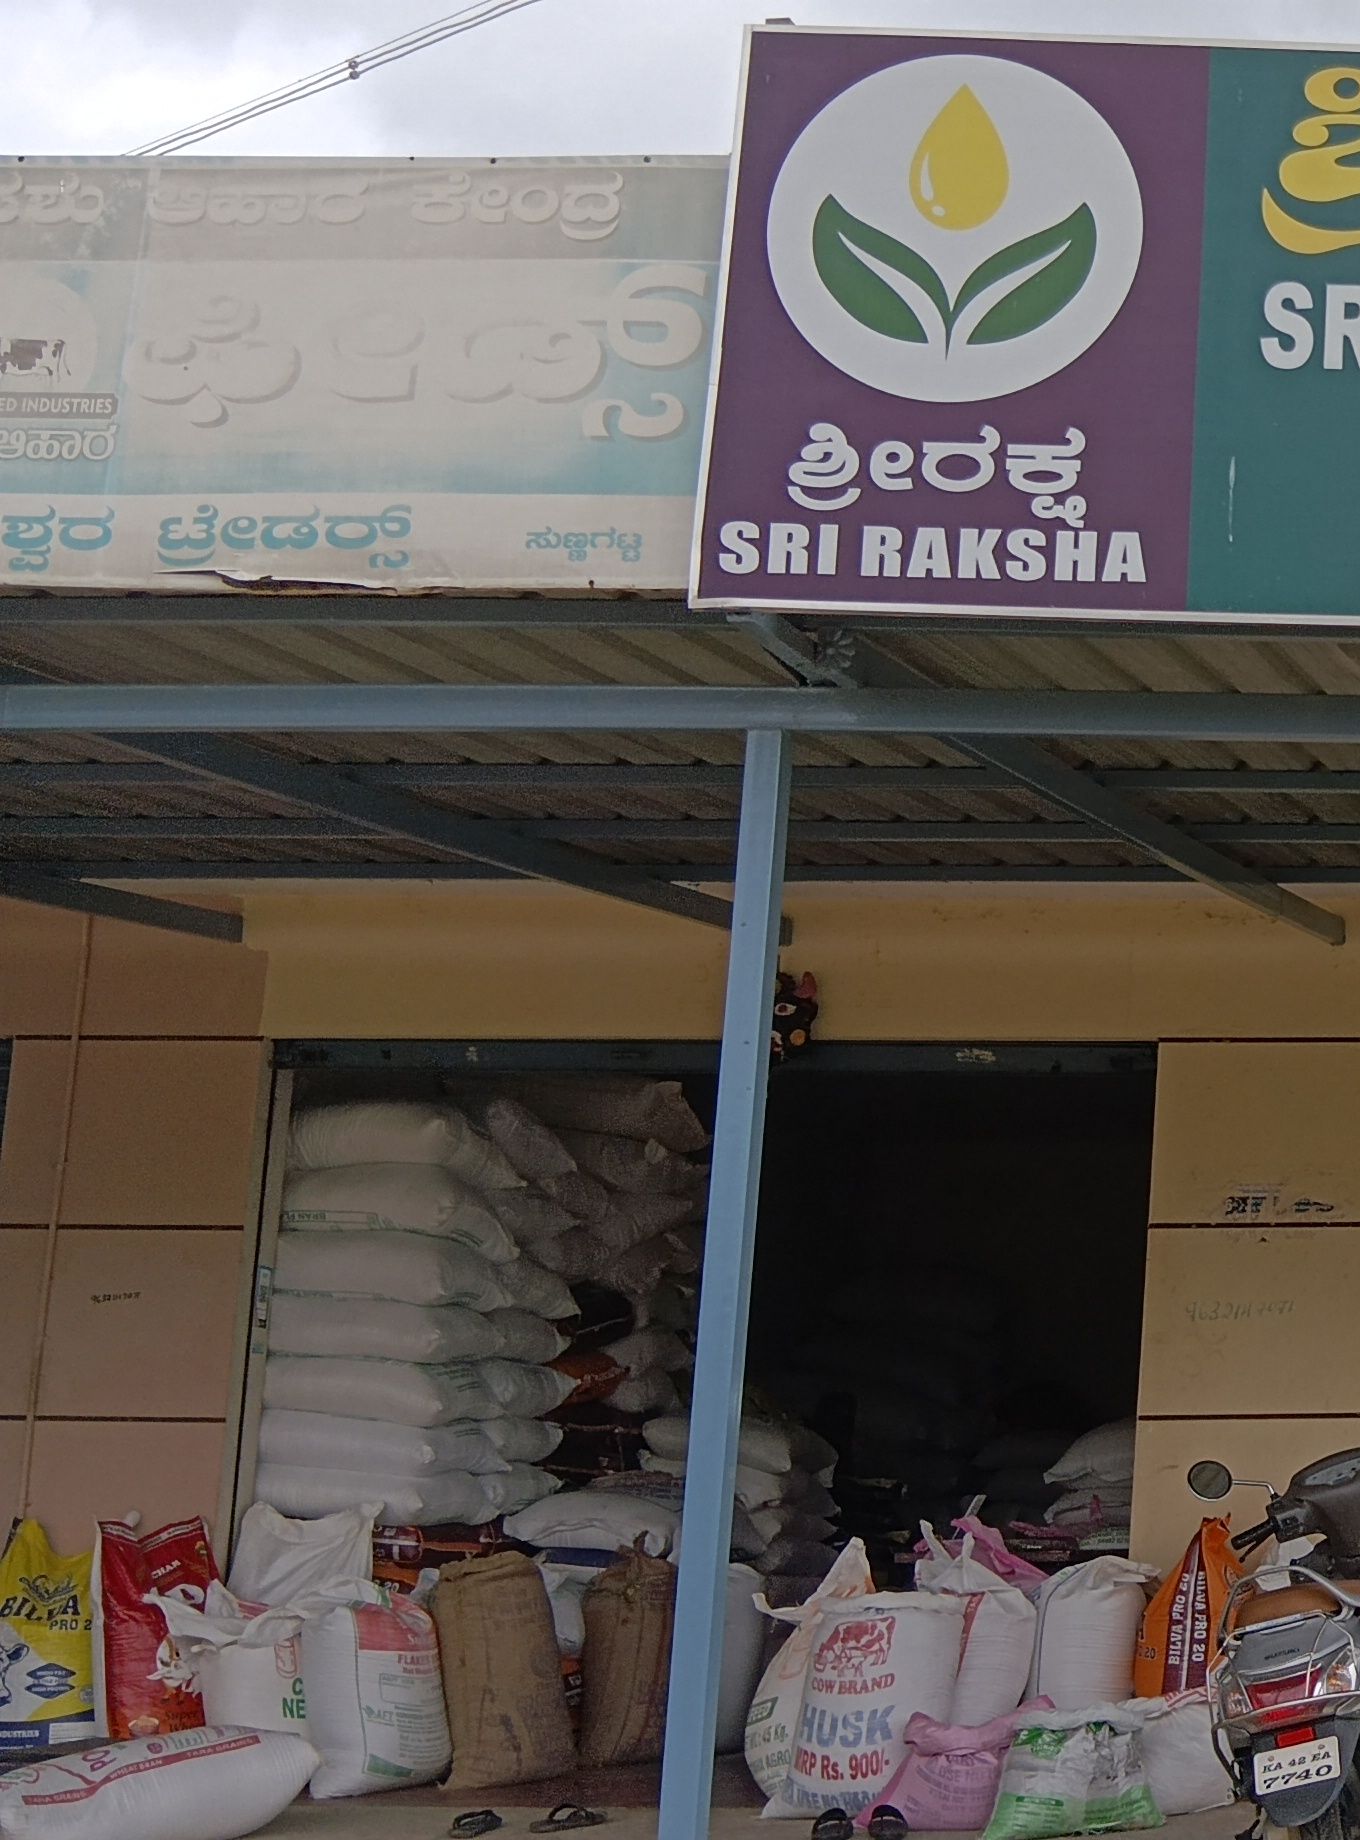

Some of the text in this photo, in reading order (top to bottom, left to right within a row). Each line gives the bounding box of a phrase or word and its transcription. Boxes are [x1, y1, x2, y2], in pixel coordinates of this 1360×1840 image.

[22, 397, 113, 413] INDUSTRIES
[787, 422, 1087, 528] ಶ್ರೀರಕ್ಷ
[718, 520, 1147, 583] SRI RAKSHA
[1172, 1594, 1186, 1620] PRO
[1191, 1571, 1207, 1663] BILVA PRO 20
[49, 1618, 93, 1631] PRO 2
[1168, 1626, 1184, 1666] BILVA
[811, 1673, 895, 1696] COW BRAND
[799, 1702, 896, 1749] HUSK
[820, 1758, 845, 1781] Rs.
[849, 1749, 890, 1781] 900/-
[1262, 1762, 1283, 1774] KA
[1311, 1751, 1331, 1763] EA
[1263, 1764, 1333, 1790] 7740
